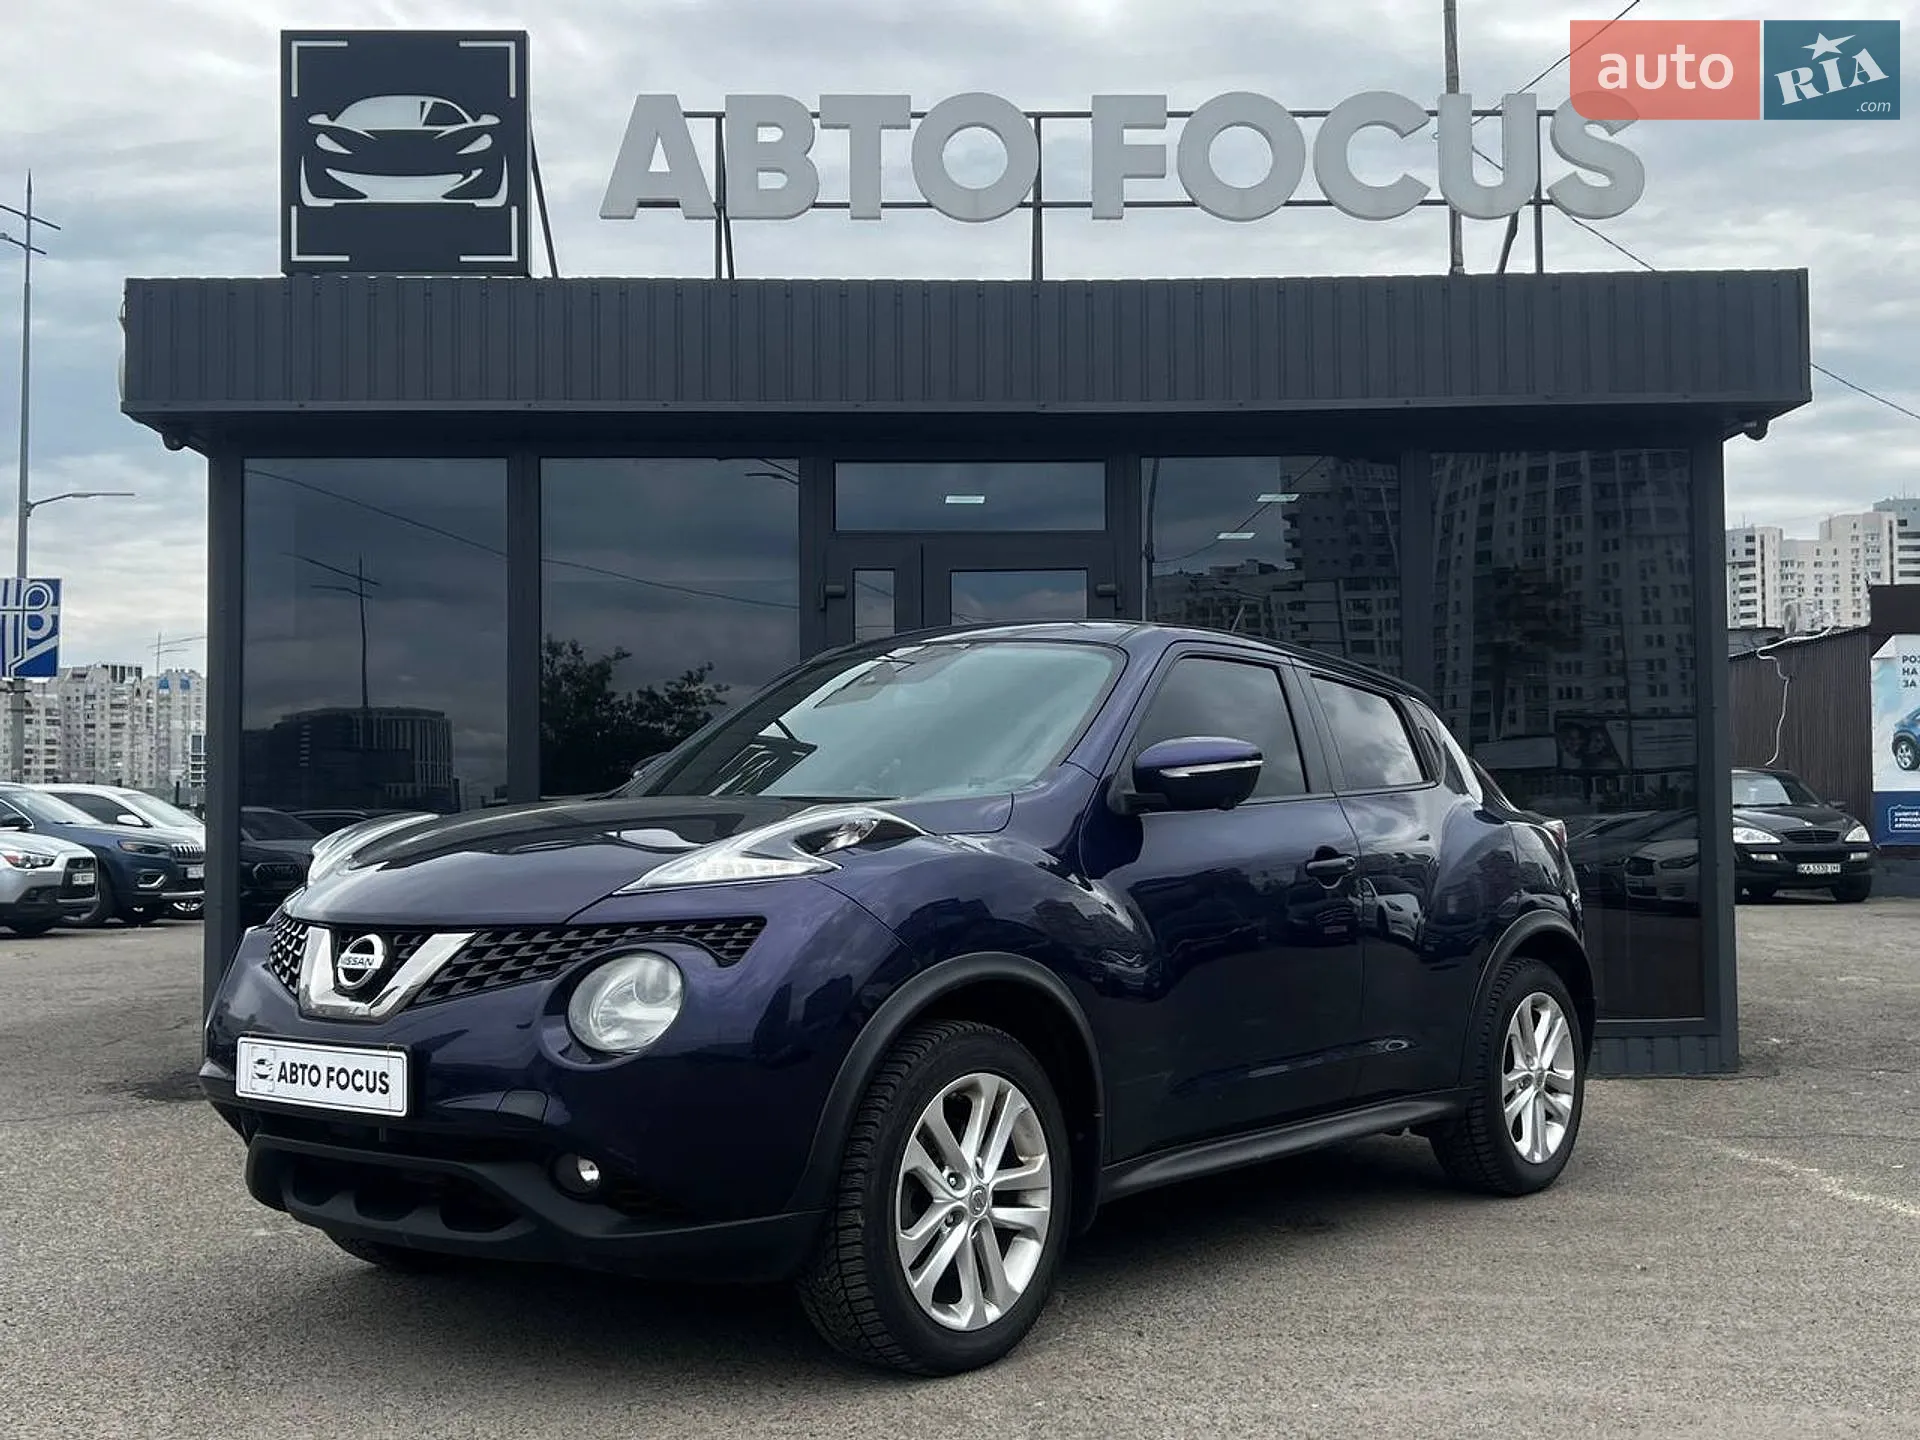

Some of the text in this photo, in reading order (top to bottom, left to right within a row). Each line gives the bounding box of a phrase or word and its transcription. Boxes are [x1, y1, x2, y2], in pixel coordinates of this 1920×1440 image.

[599, 91, 1646, 222] АВТО FOCUS
[278, 1061, 390, 1095] АВТО FOCUS
